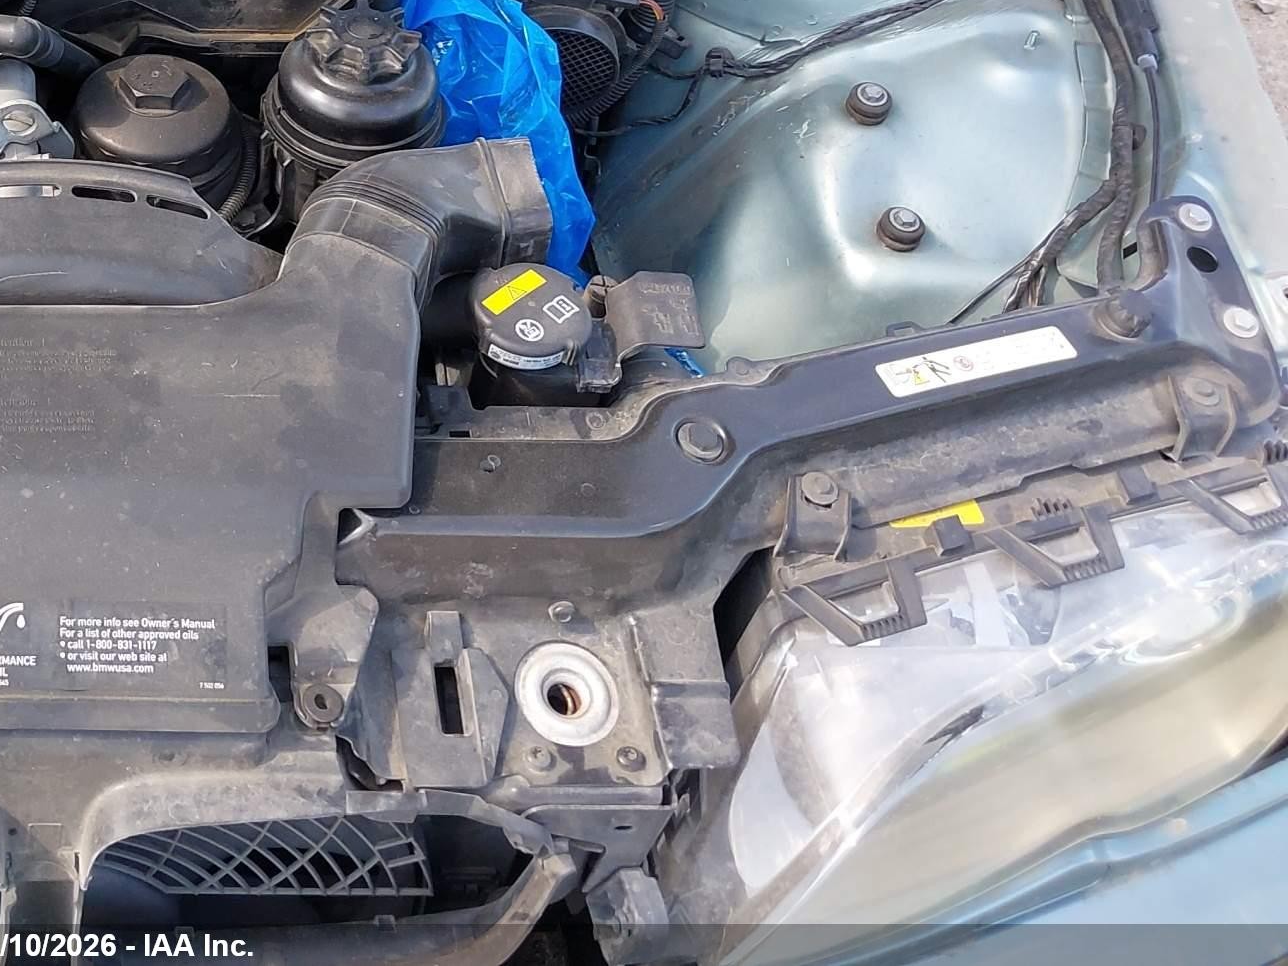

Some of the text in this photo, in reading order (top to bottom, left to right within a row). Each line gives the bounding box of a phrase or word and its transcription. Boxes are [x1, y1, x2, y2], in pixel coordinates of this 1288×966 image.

[59, 616, 77, 627] For
[77, 618, 103, 628] more
[103, 617, 121, 627] info
[122, 619, 140, 628] see
[181, 618, 216, 629] Manual
[59, 627, 199, 641] For a list of other approved oils
[67, 639, 157, 651] call 1-800-831-1117
[67, 651, 168, 662] or visit our web site at
[66, 662, 154, 673] www.bmwusa.com
